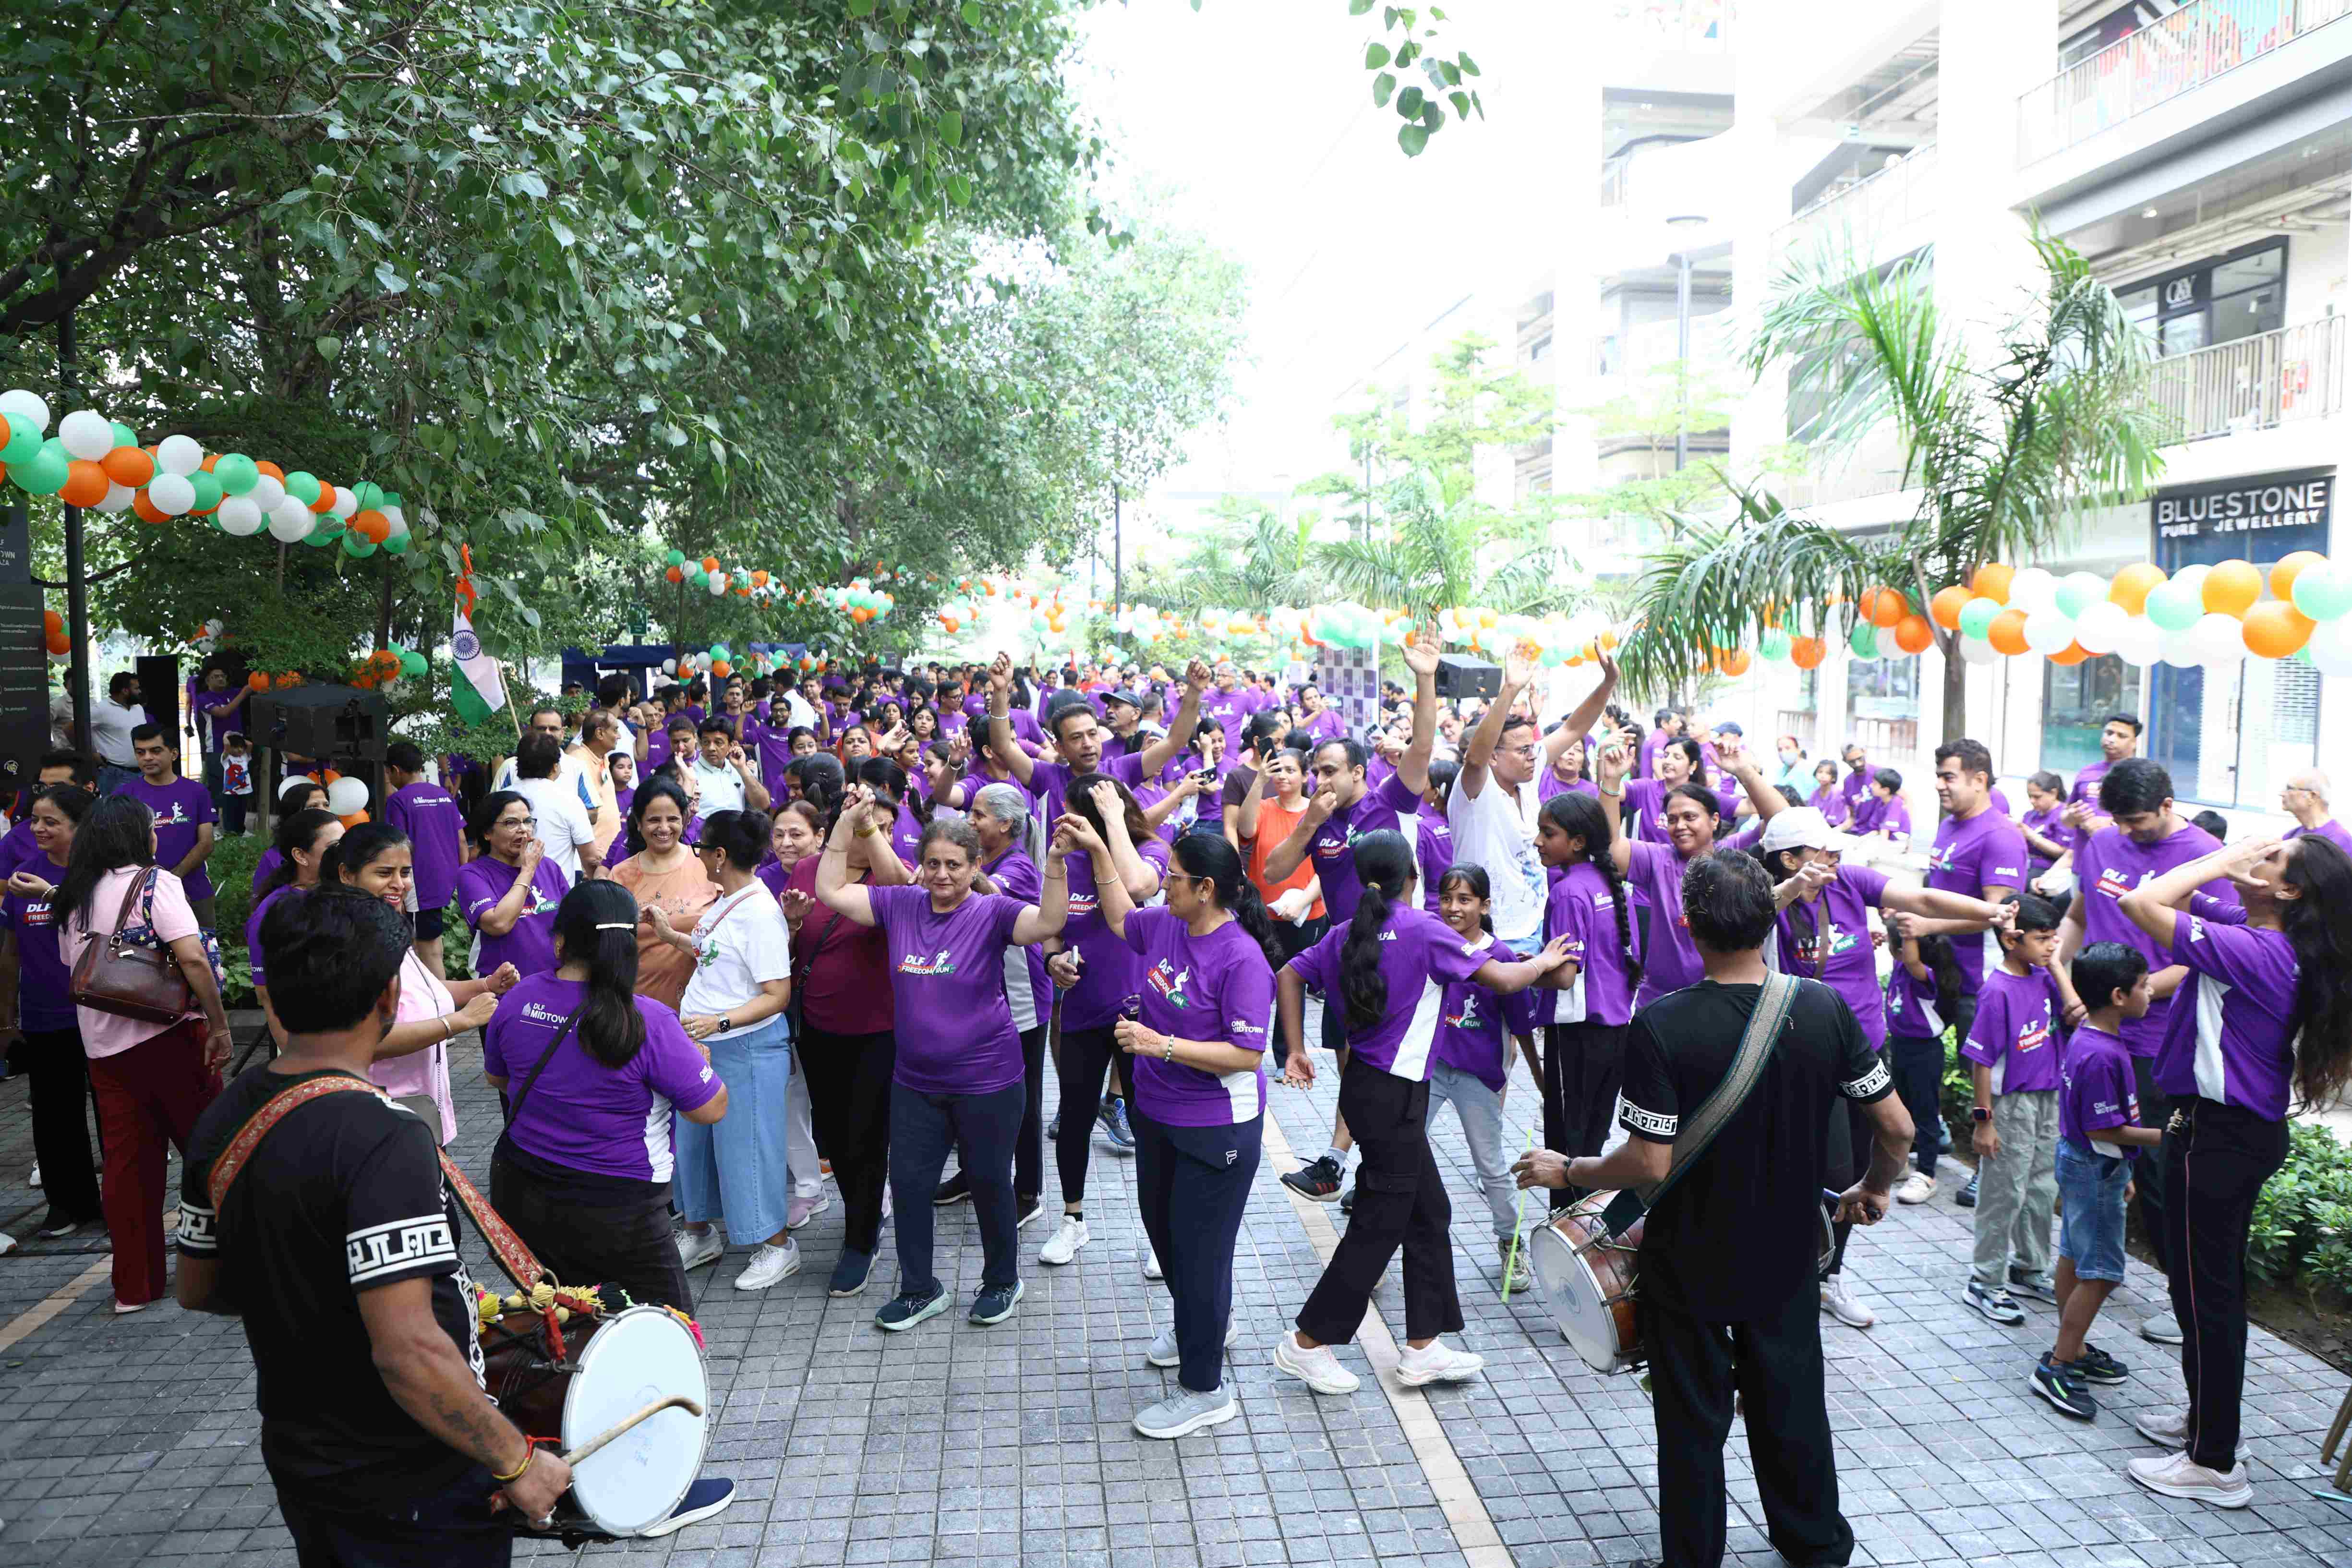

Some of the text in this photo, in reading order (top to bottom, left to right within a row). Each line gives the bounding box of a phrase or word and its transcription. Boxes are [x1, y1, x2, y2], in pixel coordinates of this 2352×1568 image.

[2158, 481, 2326, 524] BLUESTONE
[2161, 509, 2320, 537] PURE JEWELLERY
[1070, 893, 1094, 902] DLF
[26, 903, 52, 913] DLF
[540, 903, 555, 911] RUN
[1377, 932, 1389, 941] LF
[905, 954, 926, 966] DLF
[902, 966, 950, 975] FREEDOM RUN
[533, 1003, 545, 1011] DLF
[530, 1010, 568, 1024] MIDTOW
